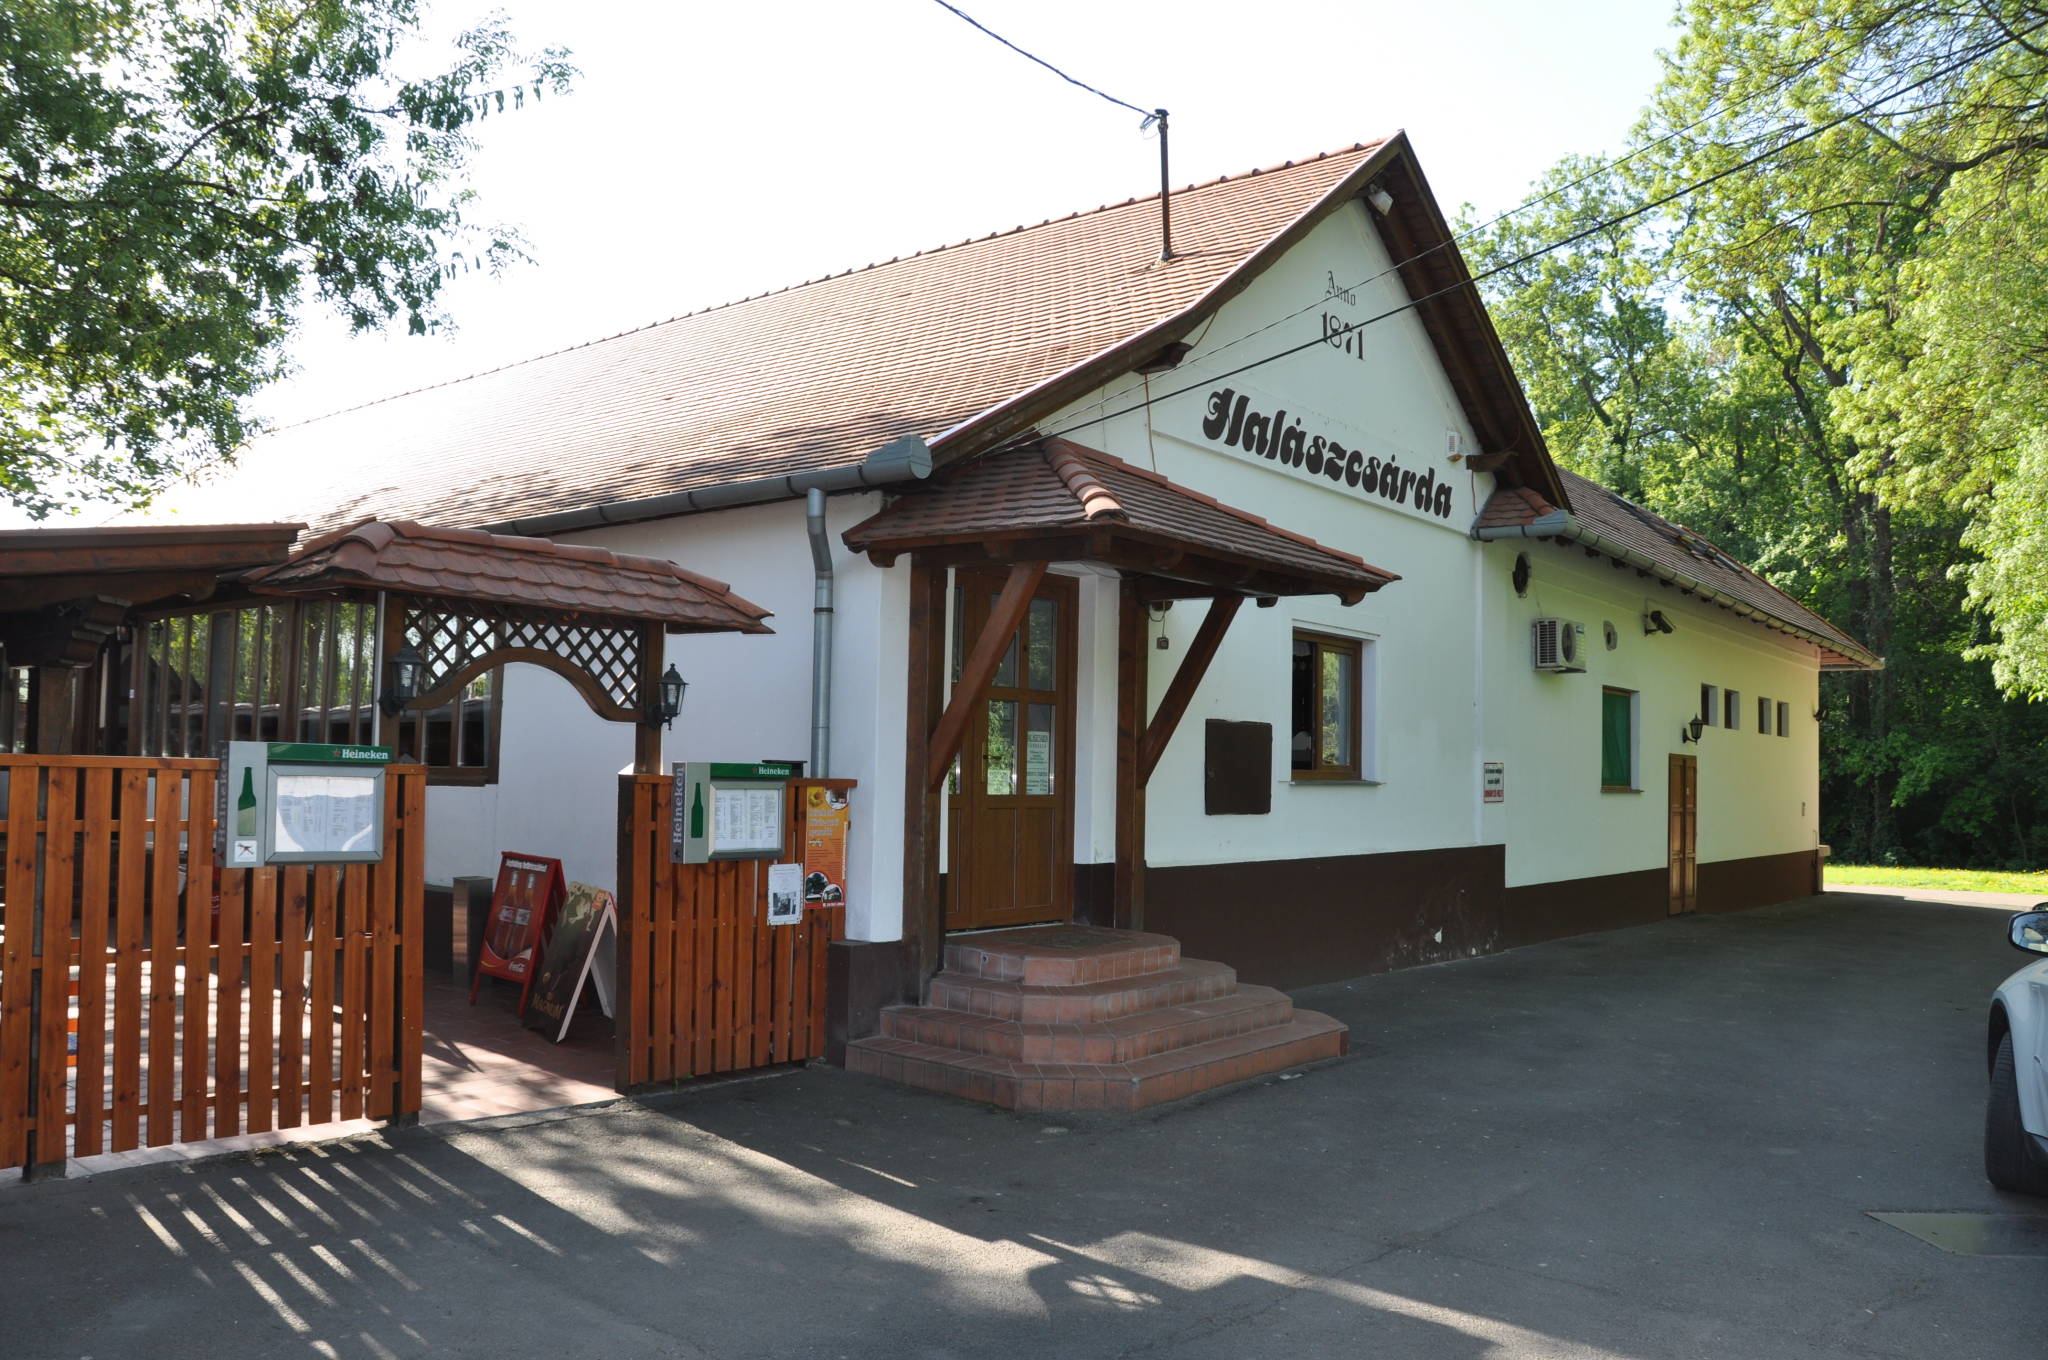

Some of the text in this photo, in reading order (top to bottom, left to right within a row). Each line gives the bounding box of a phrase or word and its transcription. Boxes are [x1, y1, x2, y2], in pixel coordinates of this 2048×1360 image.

[1325, 270, 1356, 306] Anno
[1321, 311, 1366, 361] 1871
[1202, 388, 1453, 519] Halászcsárda
[342, 749, 389, 760] Heineken
[758, 767, 790, 776] Heineken
[673, 767, 684, 844] Heineken
